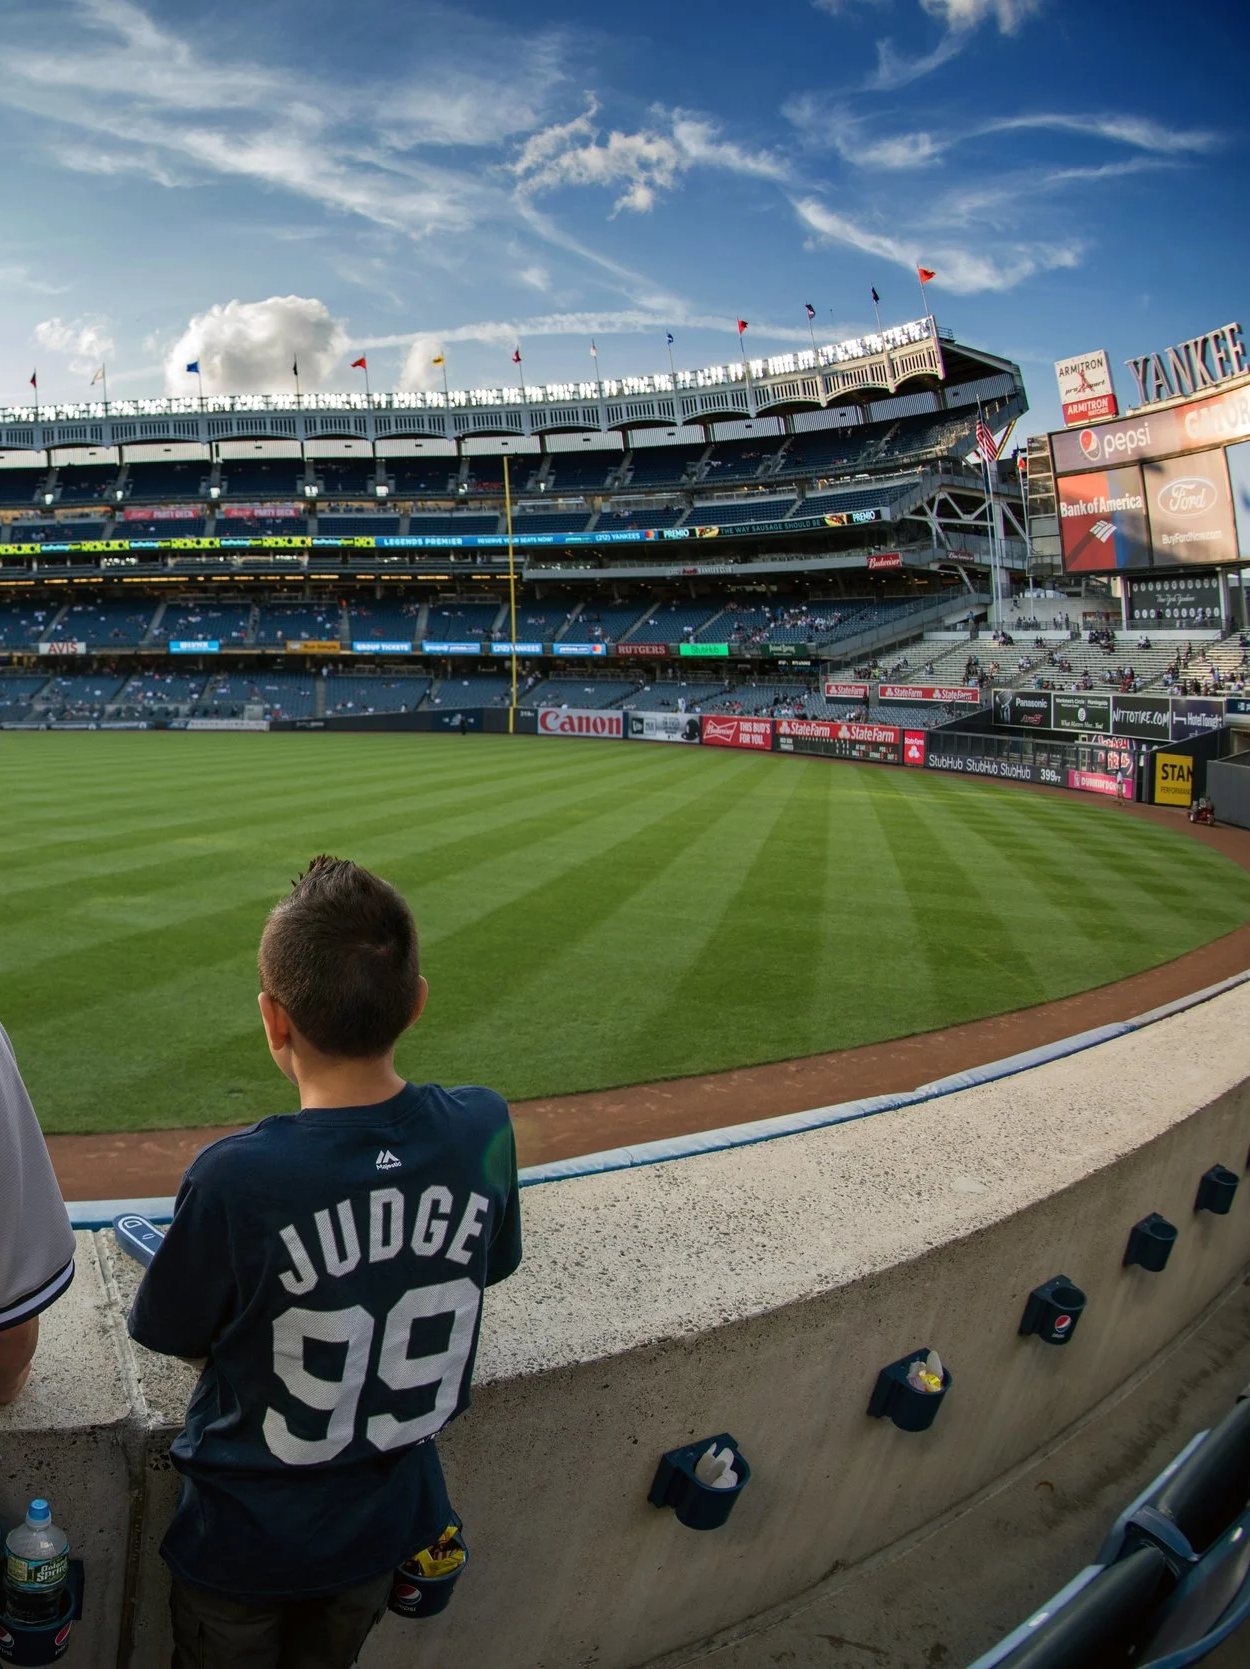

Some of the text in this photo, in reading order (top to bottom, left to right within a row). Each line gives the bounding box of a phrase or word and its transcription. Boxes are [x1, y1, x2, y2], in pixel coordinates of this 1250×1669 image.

[1059, 358, 1103, 377] ARMITRON
[1124, 322, 1249, 406] YANKEE
[1068, 398, 1108, 415] ARMITRON
[1103, 424, 1151, 458] pepsi
[1169, 483, 1206, 511] Ford
[1060, 493, 1142, 517] Bank of America
[852, 510, 876, 522] PREMIO
[663, 529, 689, 539] PREMIO
[721, 526, 733, 535] THE
[735, 525, 750, 534] WAY
[751, 523, 783, 532] SAUSAGE
[784, 521, 811, 530] SHOULD
[384, 537, 462, 546] LEGENDS PREMIER
[612, 532, 640, 540] YANKEES
[869, 555, 901, 568] Budweiser
[50, 643, 80, 655] AVIS
[618, 645, 665, 655] RUTGERS
[1016, 698, 1048, 708] Panasonic
[539, 710, 621, 736] Canon
[1112, 707, 1169, 727] NITTOTIRE.COM
[740, 721, 770, 734] THIS BUD'S
[739, 733, 764, 745] FOR YOU.
[929, 754, 1031, 779] StubHub StubHub StubHub
[376, 1161, 402, 1170] Majestic
[278, 1185, 489, 1296] JUDGE
[262, 1278, 484, 1466] 99
